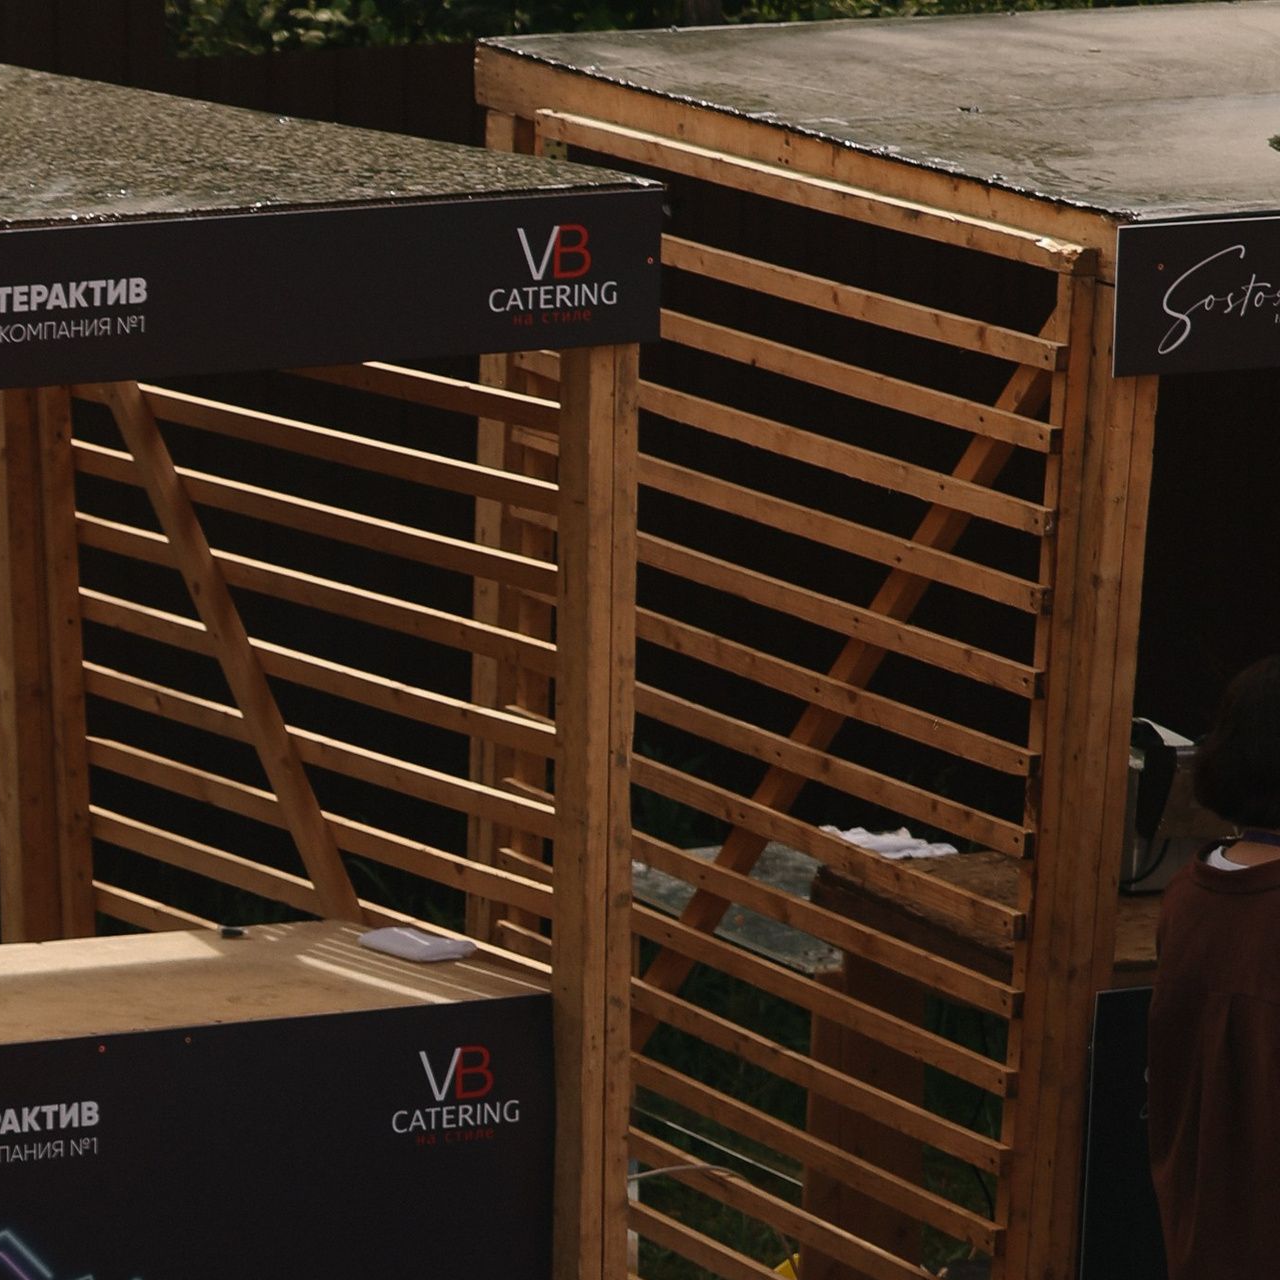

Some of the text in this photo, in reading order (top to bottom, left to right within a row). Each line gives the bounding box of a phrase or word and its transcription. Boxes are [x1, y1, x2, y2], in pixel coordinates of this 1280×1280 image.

[516, 223, 592, 281] VB
[488, 281, 618, 313] CATERING
[116, 314, 146, 335] №1
[542, 309, 592, 325] стиле
[418, 1045, 495, 1102] VB
[391, 1099, 520, 1134] CATERING
[69, 1136, 99, 1156] №1
